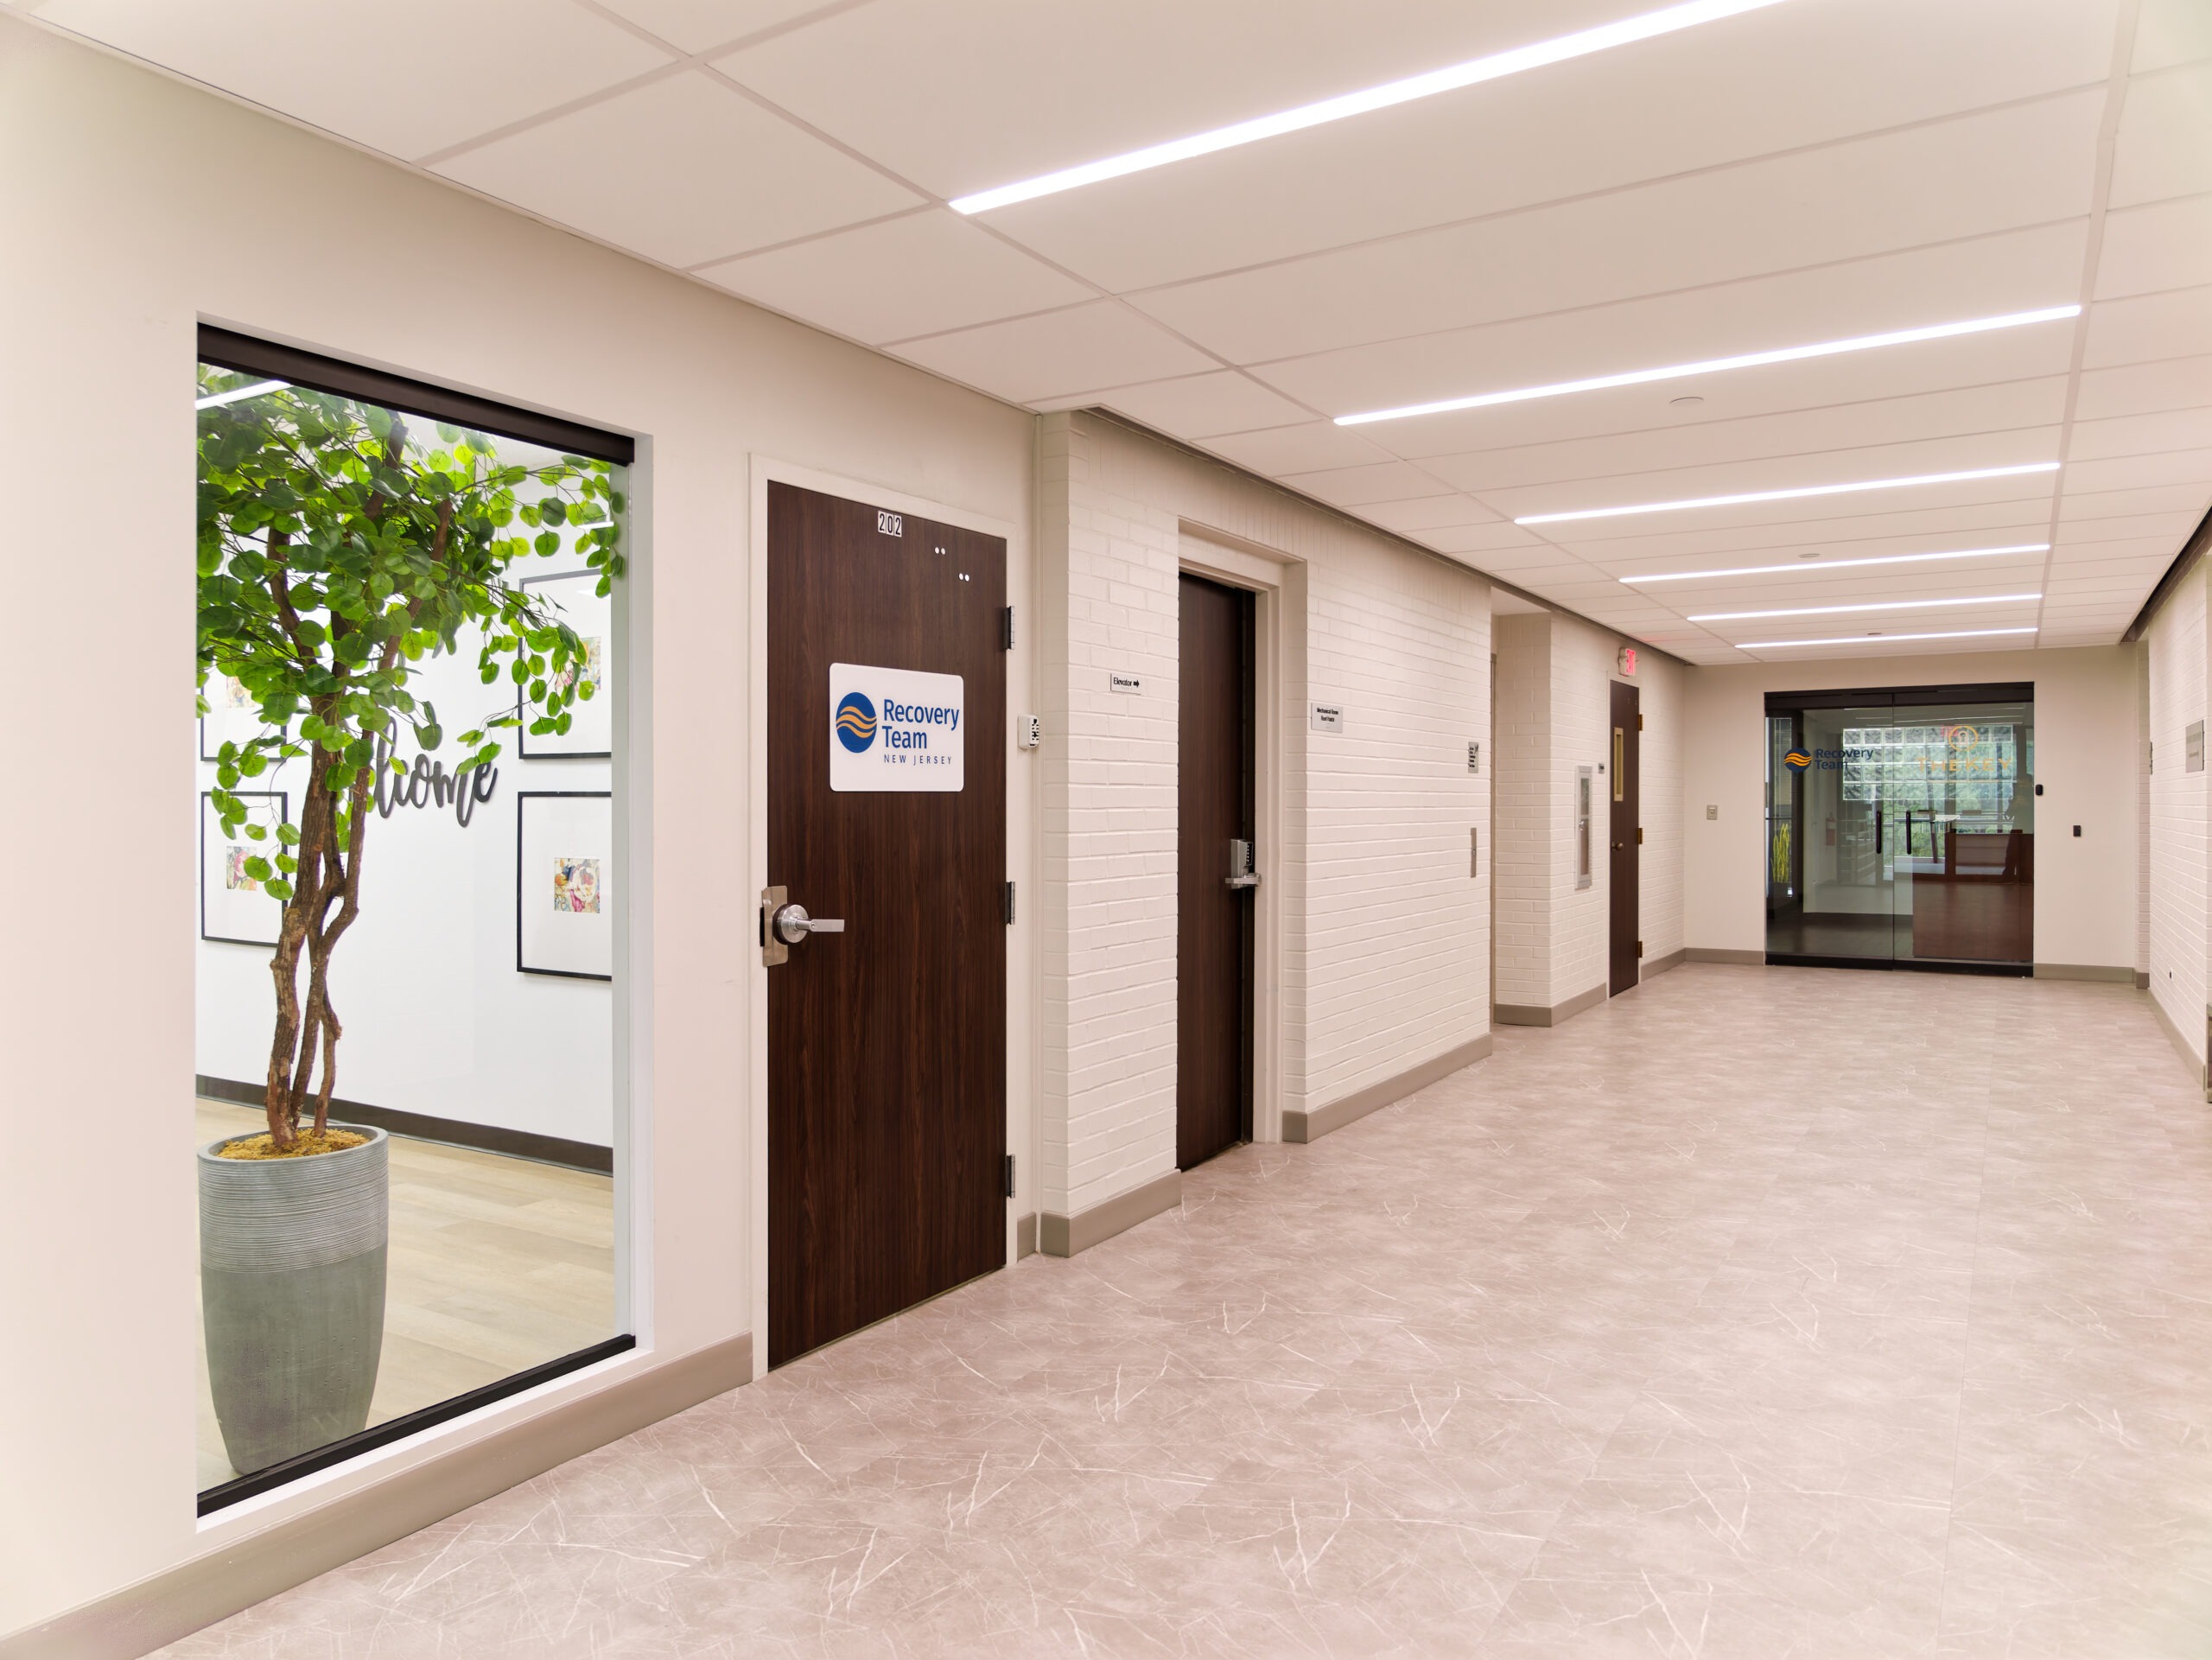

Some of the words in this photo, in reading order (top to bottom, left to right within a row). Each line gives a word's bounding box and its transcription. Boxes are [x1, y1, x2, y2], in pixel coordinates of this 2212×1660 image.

[879, 512, 902, 536] 202
[1113, 677, 1133, 687] Elevator
[883, 698, 960, 731] Recovery
[881, 725, 927, 749] Team
[884, 754, 906, 764] NEW
[912, 754, 952, 766] JERSEY
[1815, 747, 1874, 760] Recovery
[1815, 760, 1848, 770] Team
